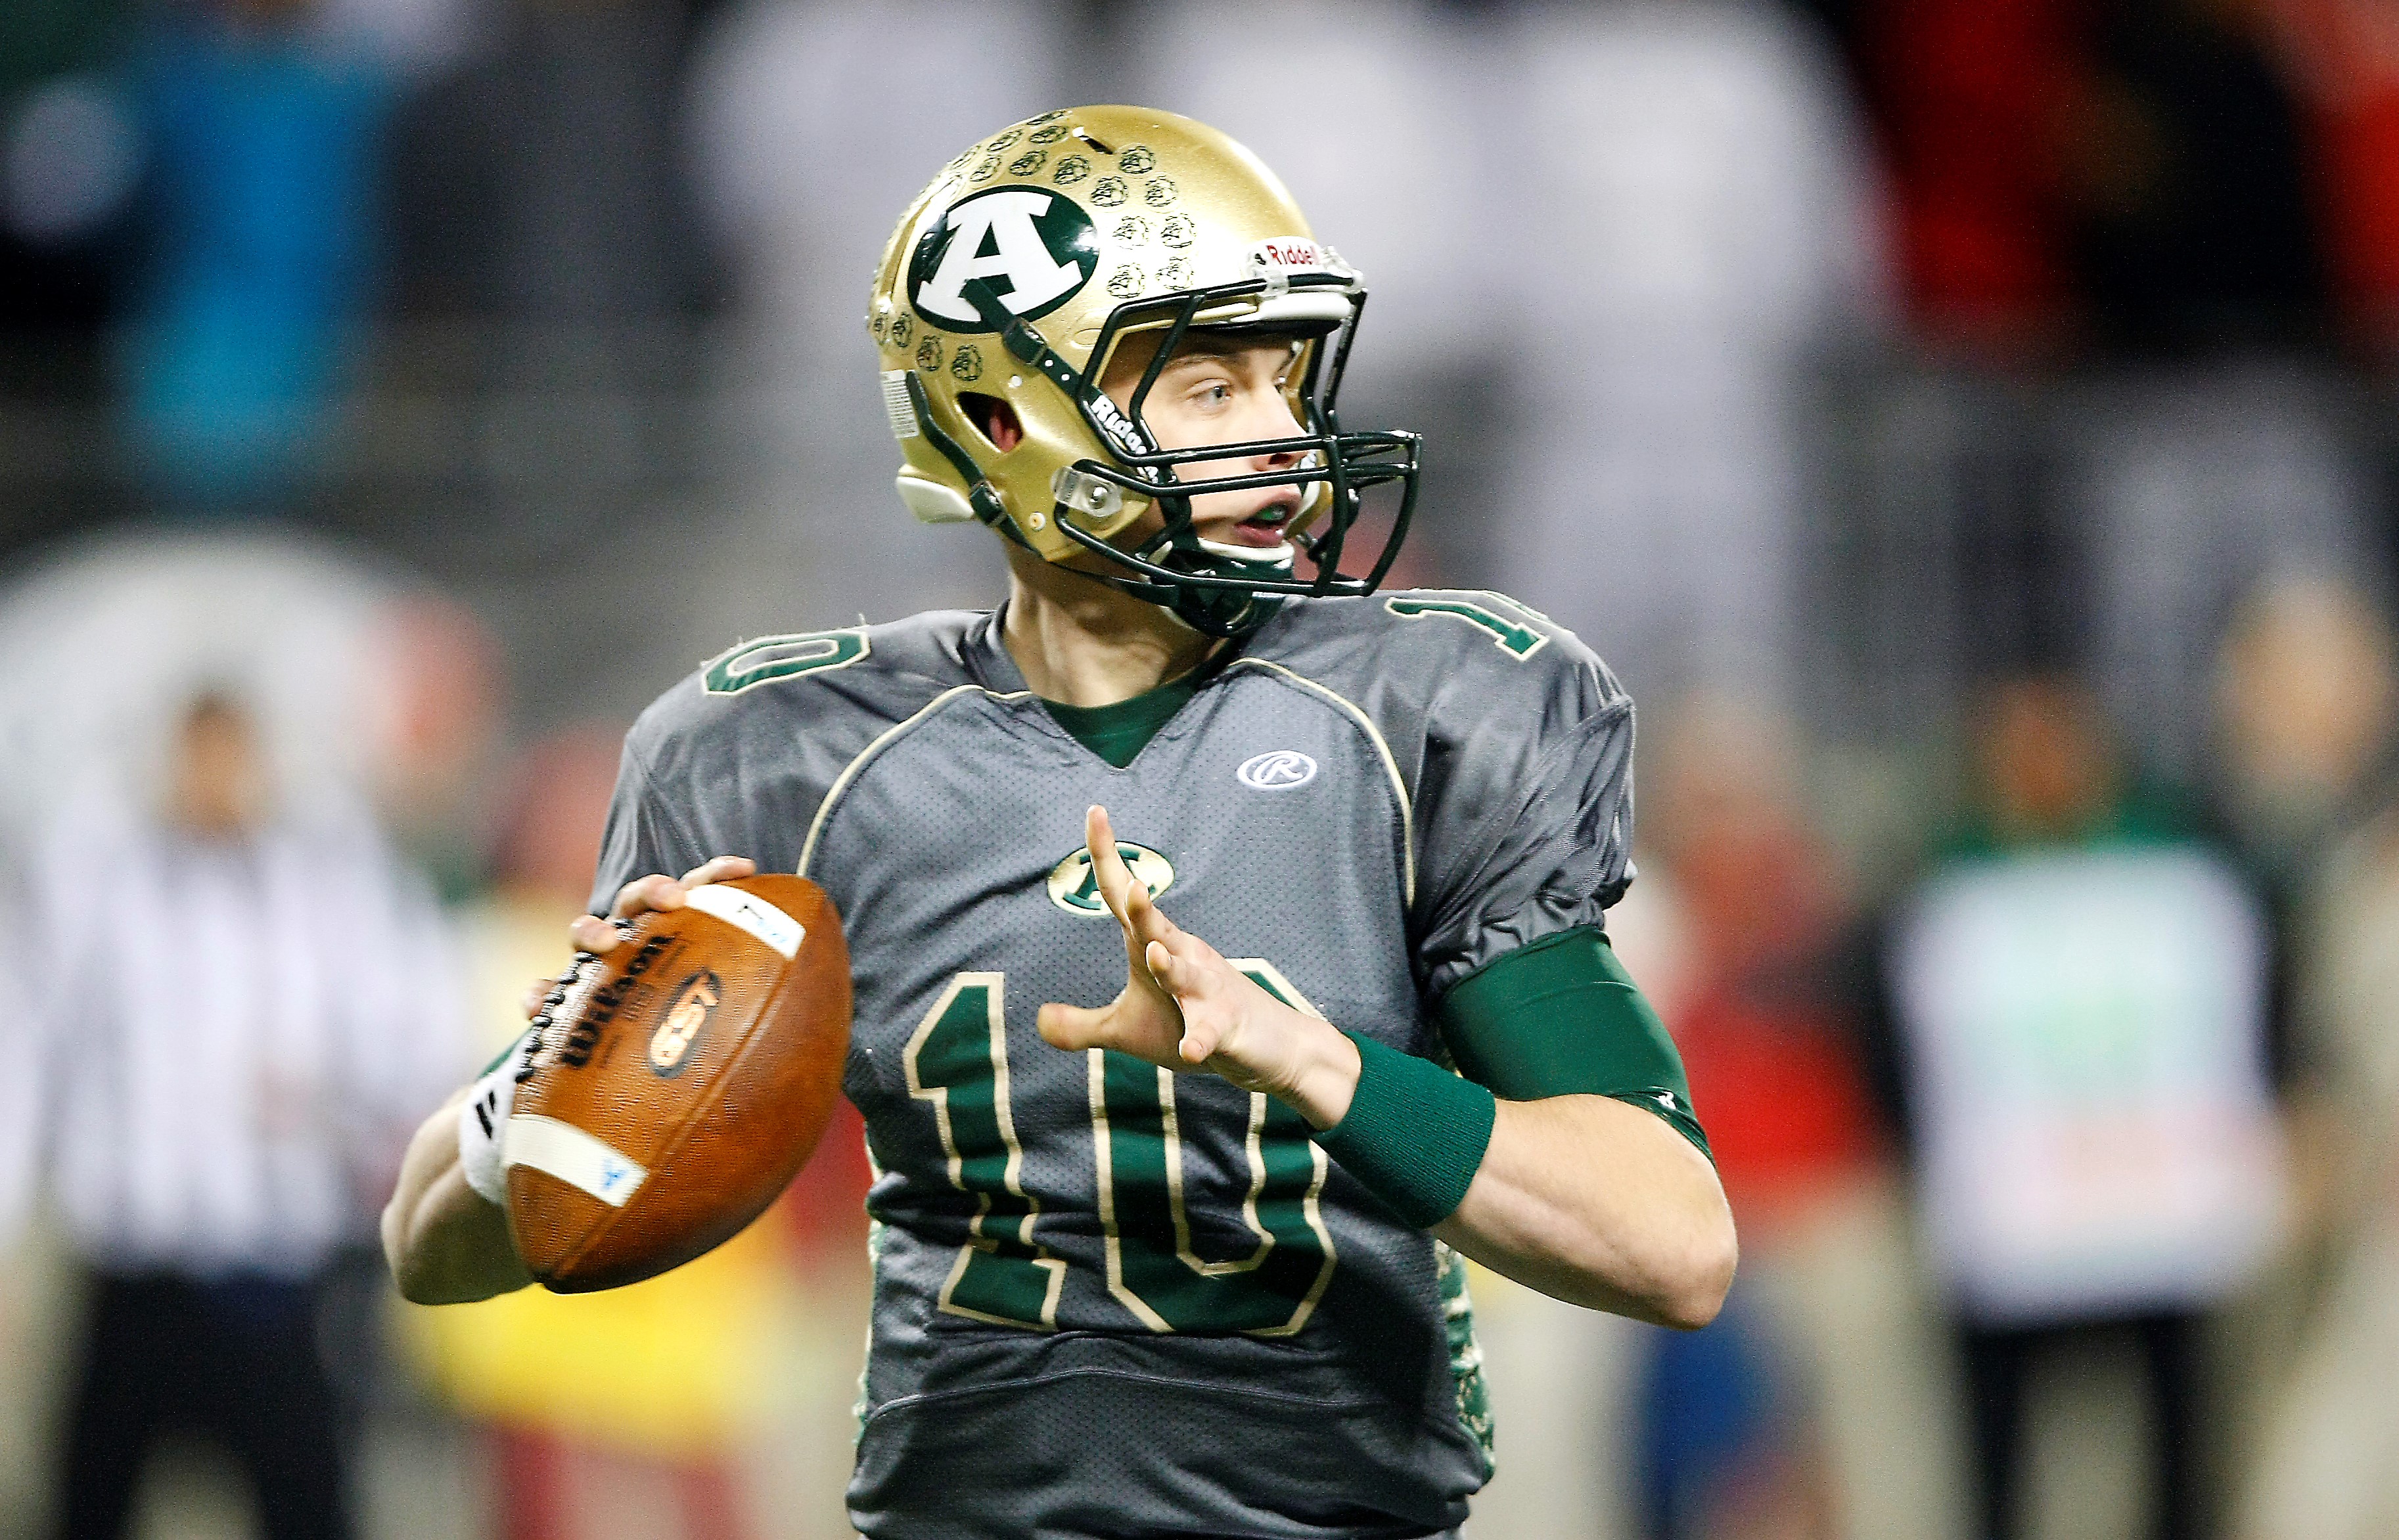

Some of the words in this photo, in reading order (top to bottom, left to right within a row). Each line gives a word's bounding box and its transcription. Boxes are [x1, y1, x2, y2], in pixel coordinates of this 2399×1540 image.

[917, 191, 1084, 322] A
[560, 931, 681, 1067] Wilson
[904, 959, 1337, 1338] 10
